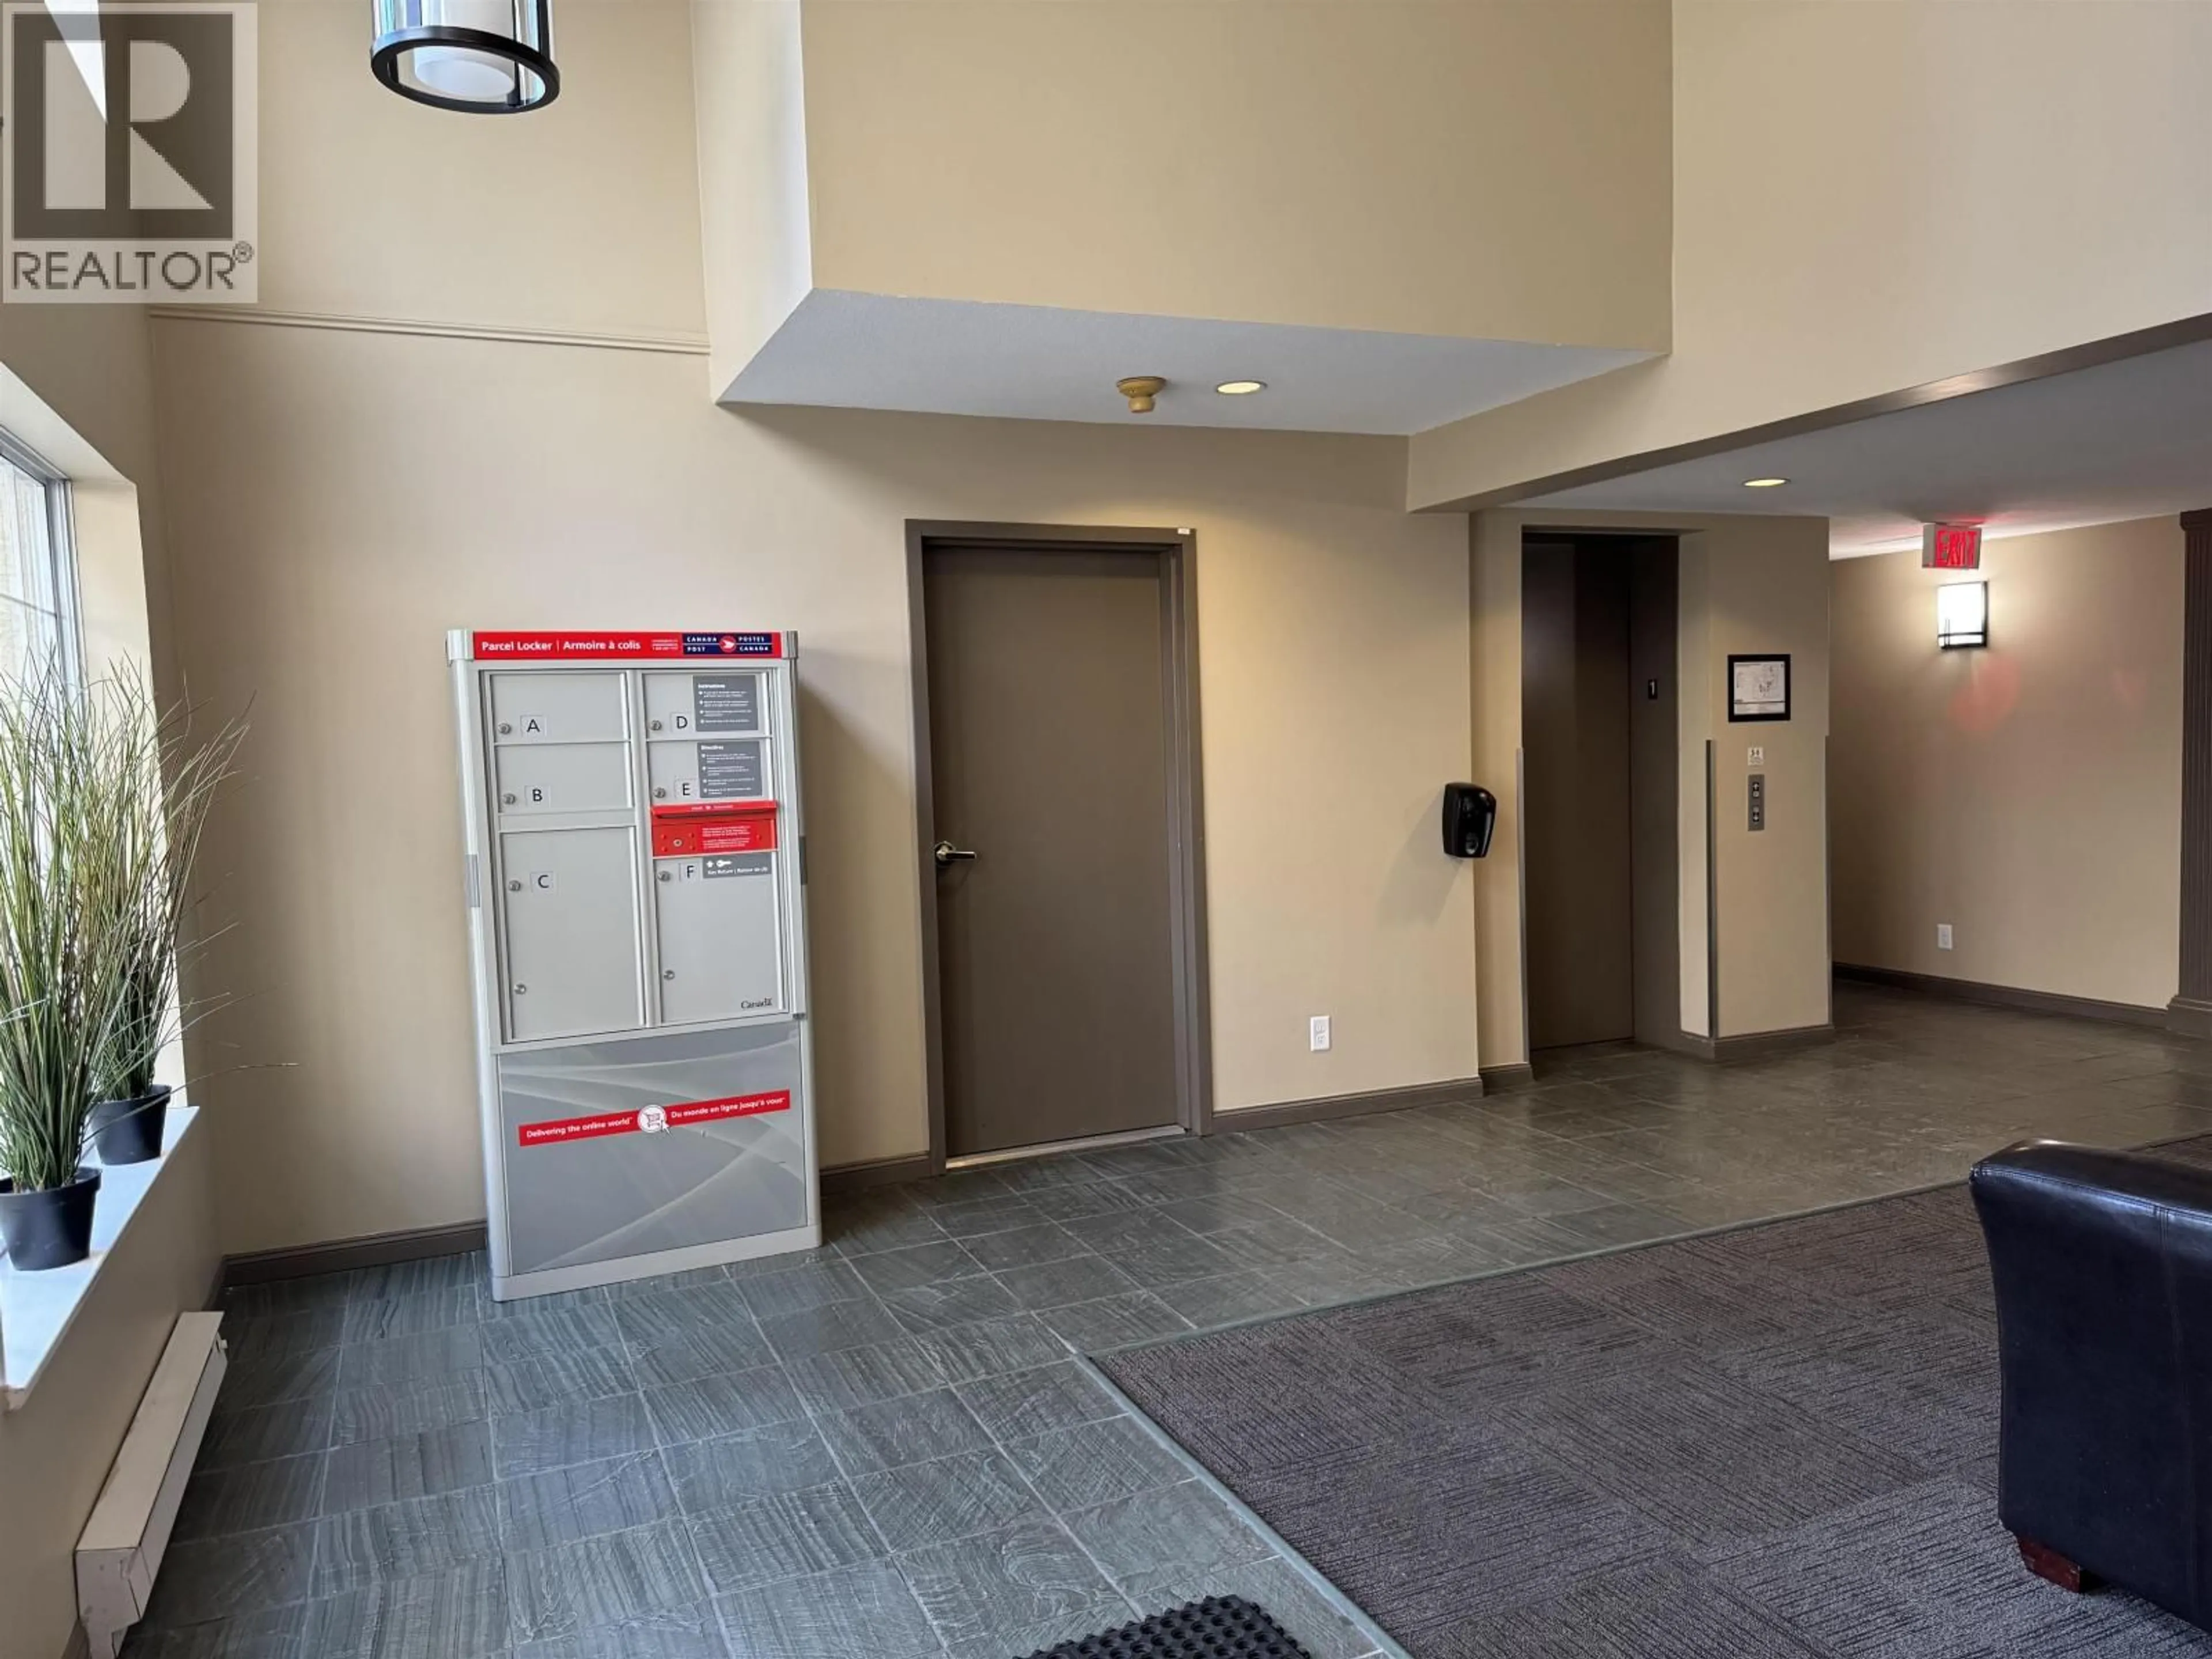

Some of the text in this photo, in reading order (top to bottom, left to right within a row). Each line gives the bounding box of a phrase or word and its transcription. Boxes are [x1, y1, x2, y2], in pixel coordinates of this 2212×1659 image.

[1936, 531, 1978, 566] EXIT
[482, 641, 514, 651] Parcel
[517, 641, 552, 650] Locker
[563, 641, 605, 650] Armoire
[608, 640, 615, 649] à
[618, 640, 641, 650] colis
[527, 719, 540, 732] A
[676, 716, 688, 729] D
[532, 788, 543, 801] B
[682, 782, 691, 796] E
[687, 865, 694, 878] F
[538, 874, 550, 888] C
[683, 1107, 709, 1116] monde
[721, 1104, 738, 1112] ligne
[527, 1127, 566, 1138] Delivering
[567, 1124, 581, 1132] the
[582, 1121, 606, 1131] online
